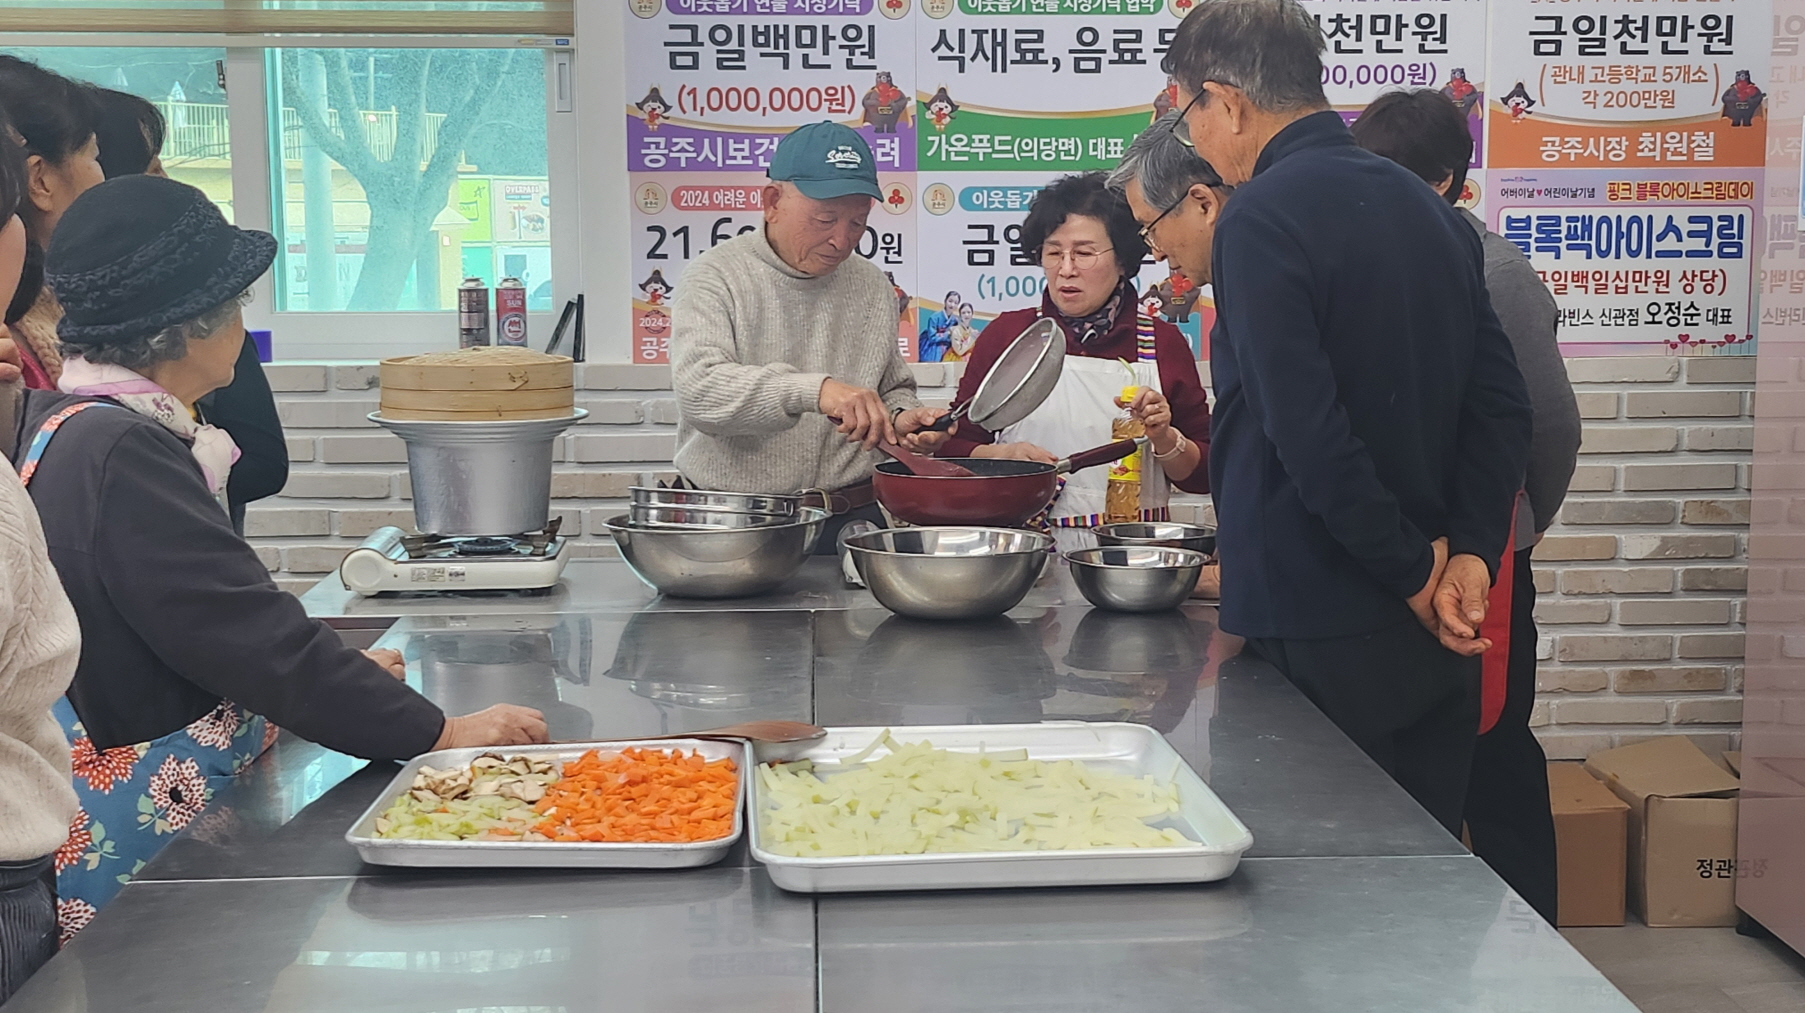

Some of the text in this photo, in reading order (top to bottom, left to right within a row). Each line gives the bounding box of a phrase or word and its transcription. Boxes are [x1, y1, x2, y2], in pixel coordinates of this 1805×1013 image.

[663, 23, 878, 71] 금일백만원
[1314, 13, 1449, 54] 천만원
[1528, 14, 1735, 57] 금일천만원
[930, 27, 1061, 74] 식재료,
[1068, 26, 1147, 74] 음료
[1320, 61, 1437, 89] 00,000원)
[1550, 64, 1708, 85] 관내 고등학교 5개소
[677, 83, 856, 116] (1,000,000원)
[1581, 89, 1676, 110] 각 200만원
[640, 136, 778, 169] 공주시보건
[926, 133, 1125, 162] 가온푸드(의당면) 대표
[1538, 131, 1716, 162] 공주시장 최원철
[680, 189, 764, 208] 2024 어려운 이
[1606, 181, 1633, 202] 핑크
[1635, 181, 1755, 202] 블록아이스크림데이
[1503, 213, 1745, 260] 블록팩아이스크림
[1537, 268, 1727, 297] 일백일십만원 상당)
[1557, 301, 1733, 328] 라빈스 신관점 오정순 대표
[1696, 858, 1737, 879] 정관
